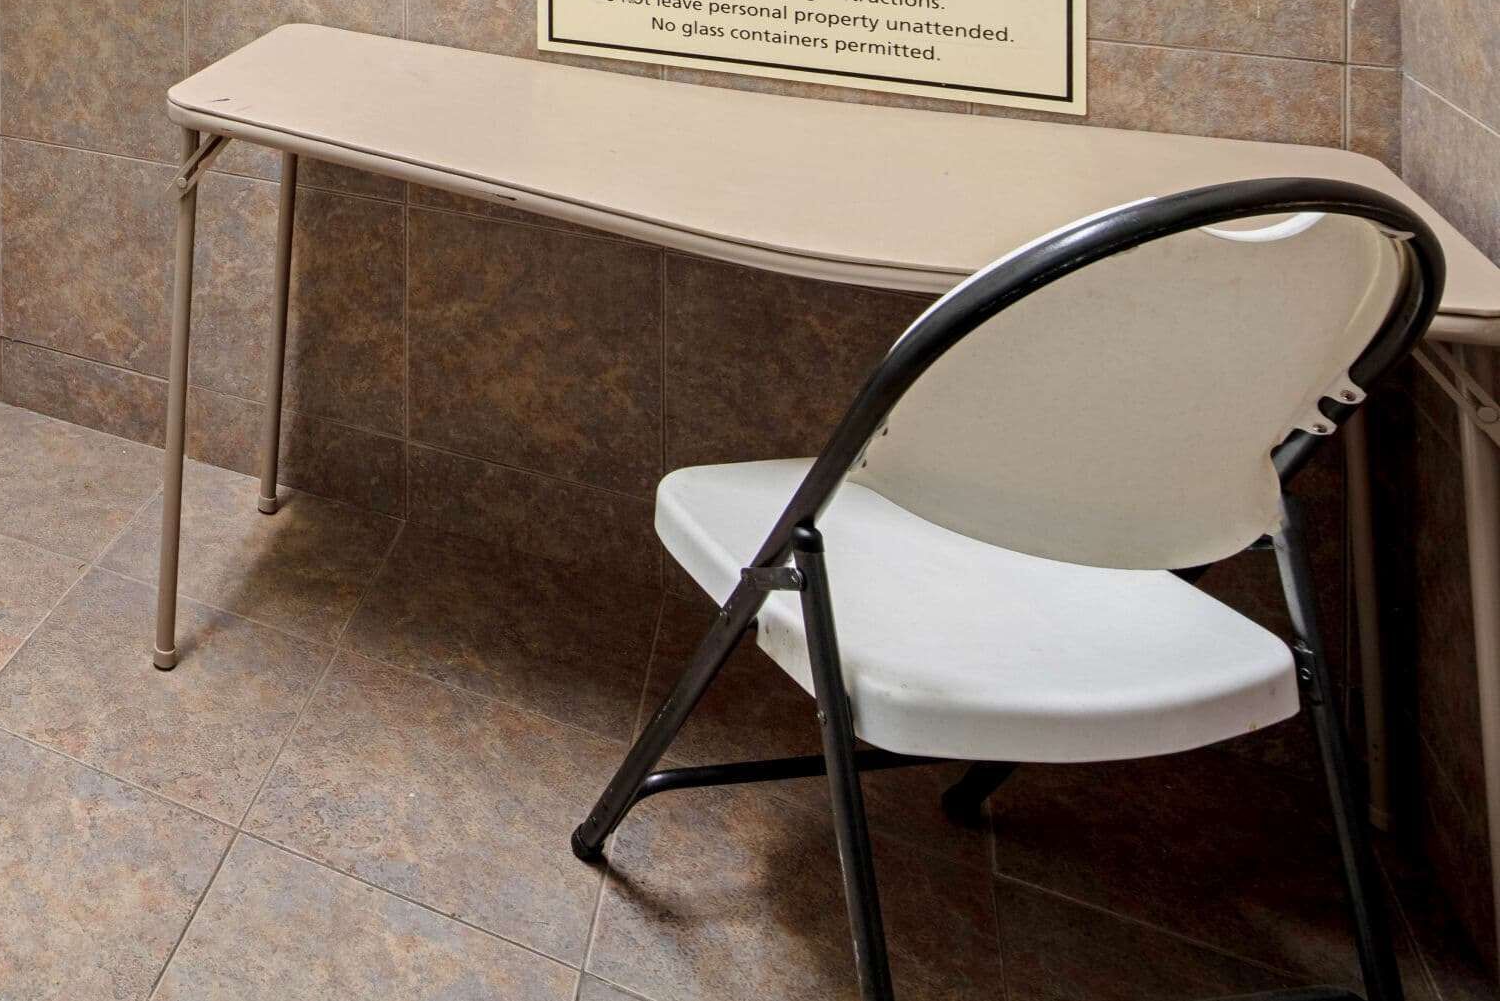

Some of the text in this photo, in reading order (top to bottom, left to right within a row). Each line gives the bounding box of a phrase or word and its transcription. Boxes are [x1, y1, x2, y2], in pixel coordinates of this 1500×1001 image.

[652, 17, 940, 61] No glass containers permitted.
[709, 2, 787, 20] personal
[795, 10, 879, 32] property
[886, 19, 1014, 44] unattended.
